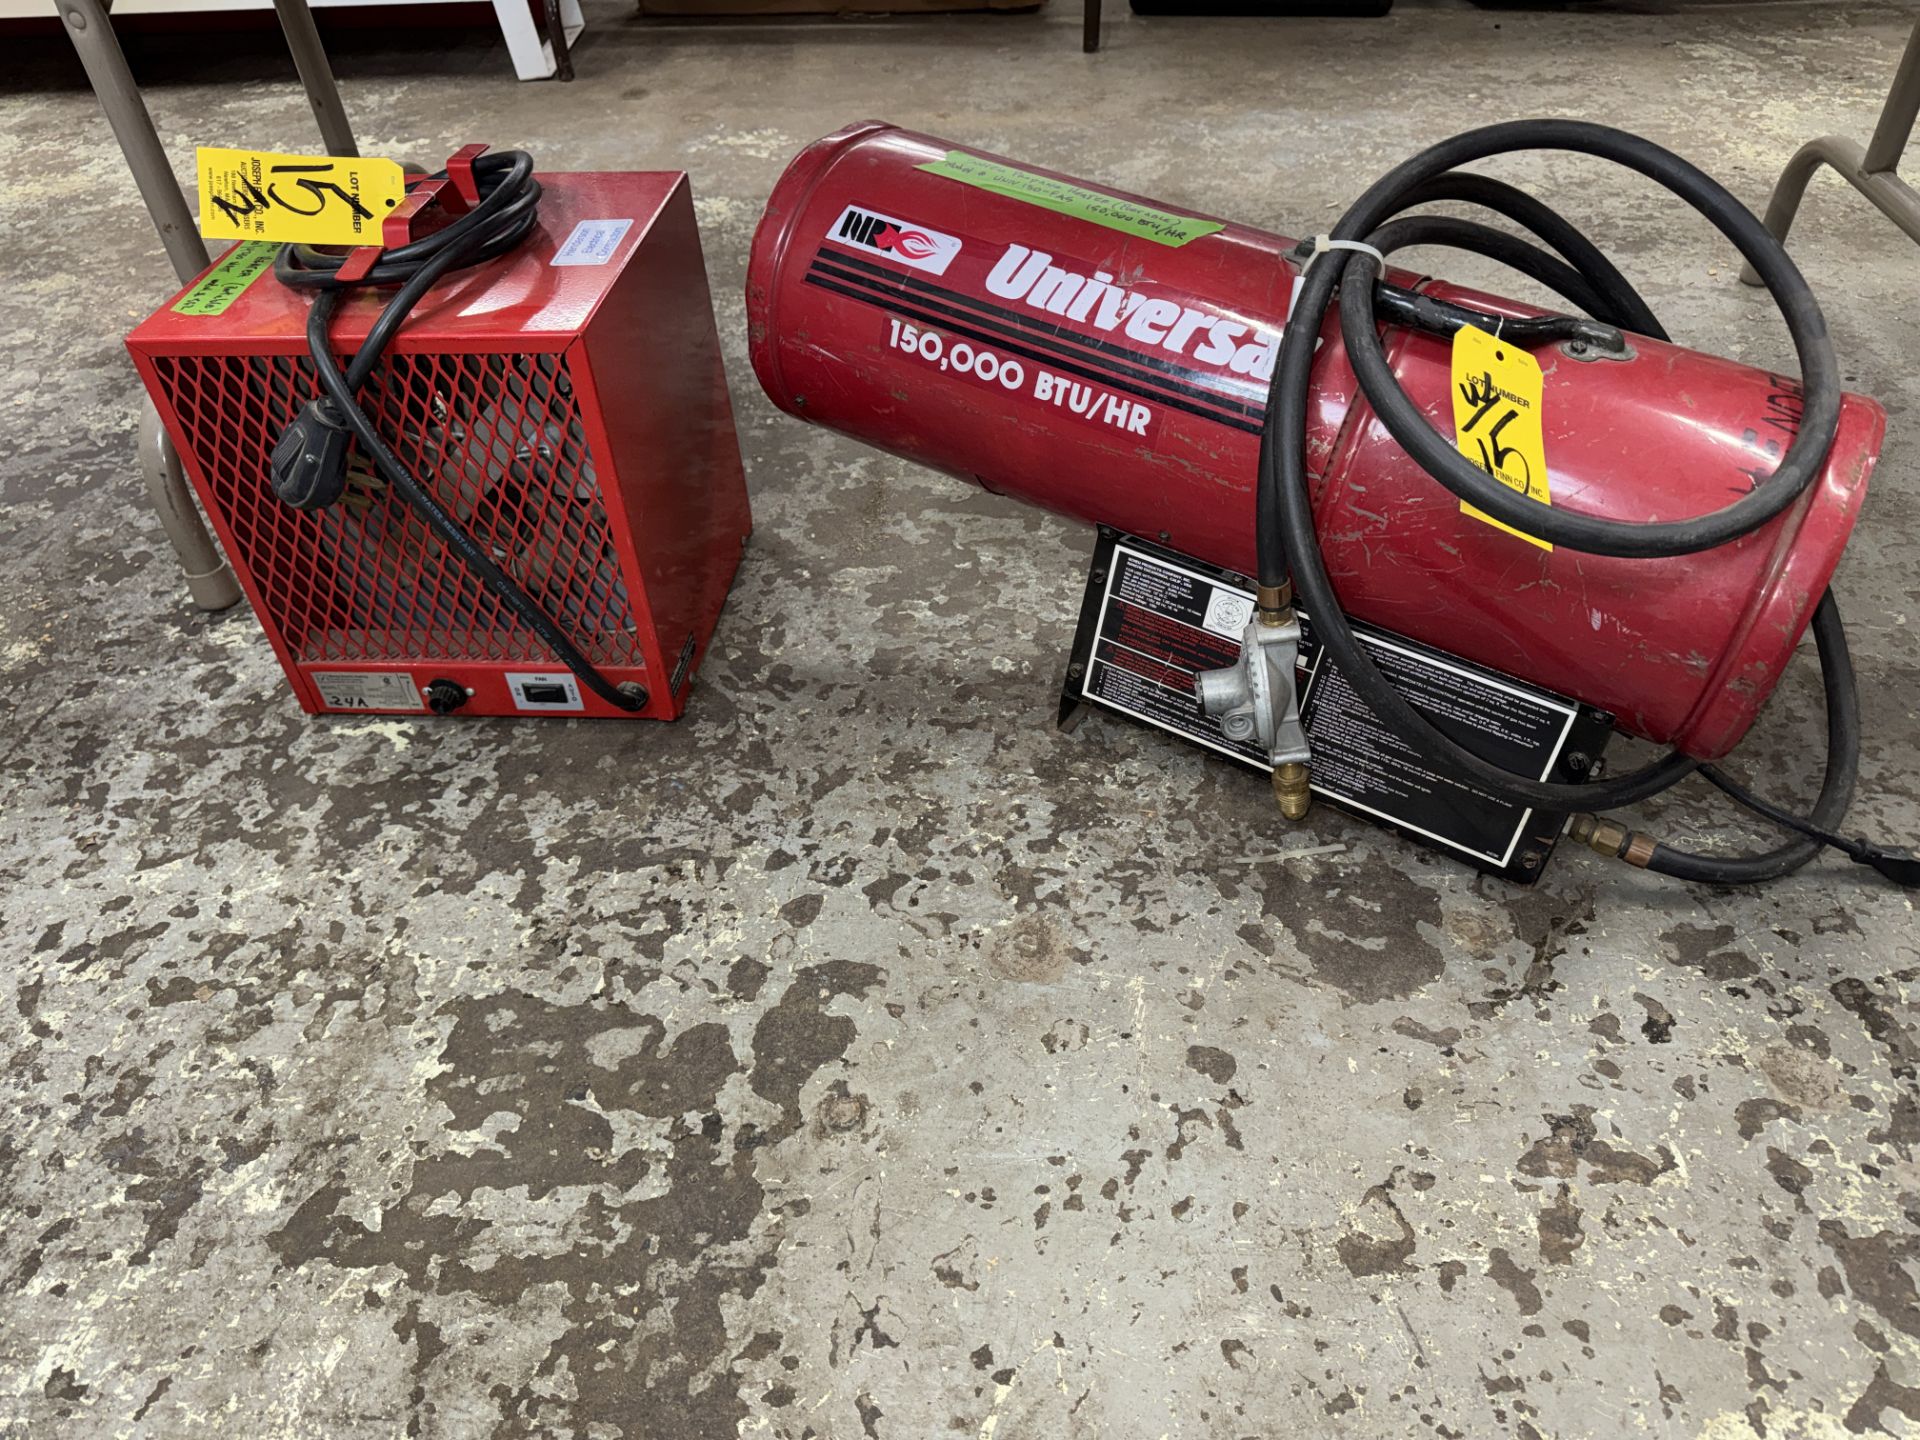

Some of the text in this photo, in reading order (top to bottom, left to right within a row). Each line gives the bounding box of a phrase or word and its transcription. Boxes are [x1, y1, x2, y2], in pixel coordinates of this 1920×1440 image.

[251, 156, 262, 186] JOSEPH
[349, 171, 362, 235] LOT NMBER
[985, 243, 1284, 383] Universa
[889, 319, 1152, 437] 150,000 BTU/HR
[1466, 372, 1485, 388] LOT
[1495, 469, 1513, 485] FINN
[420, 494, 443, 521] WATER
